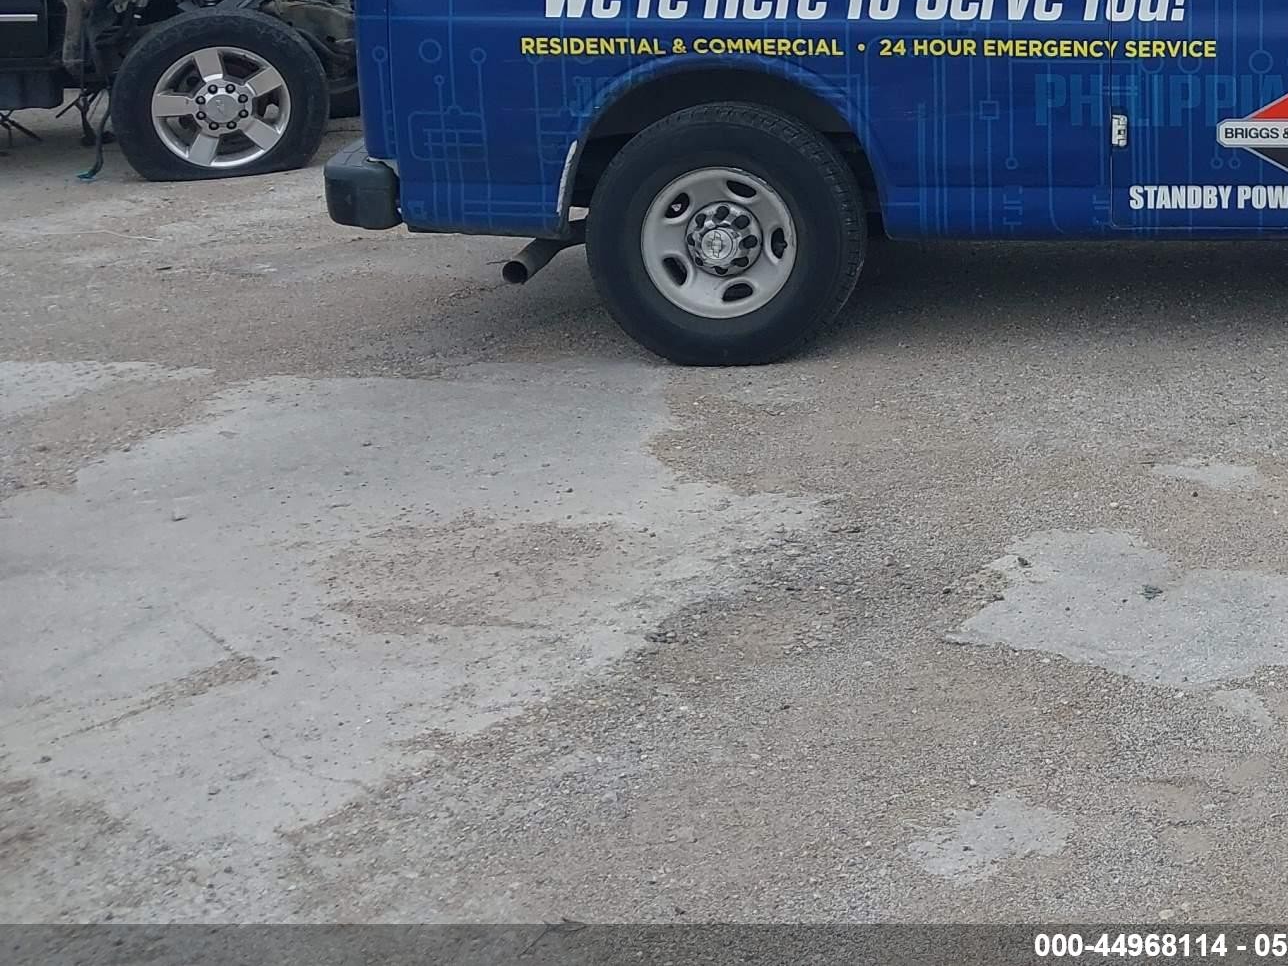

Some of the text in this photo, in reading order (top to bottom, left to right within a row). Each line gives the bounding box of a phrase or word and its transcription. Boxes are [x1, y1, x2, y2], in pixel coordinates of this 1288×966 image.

[521, 38, 844, 56] RESIDENTIAL & COMMERCIAL
[879, 39, 1216, 58] 24 HOUR EMERGENCY SERVICE
[1224, 127, 1279, 139] BRIGGS
[1129, 185, 1232, 210] STANDBY
